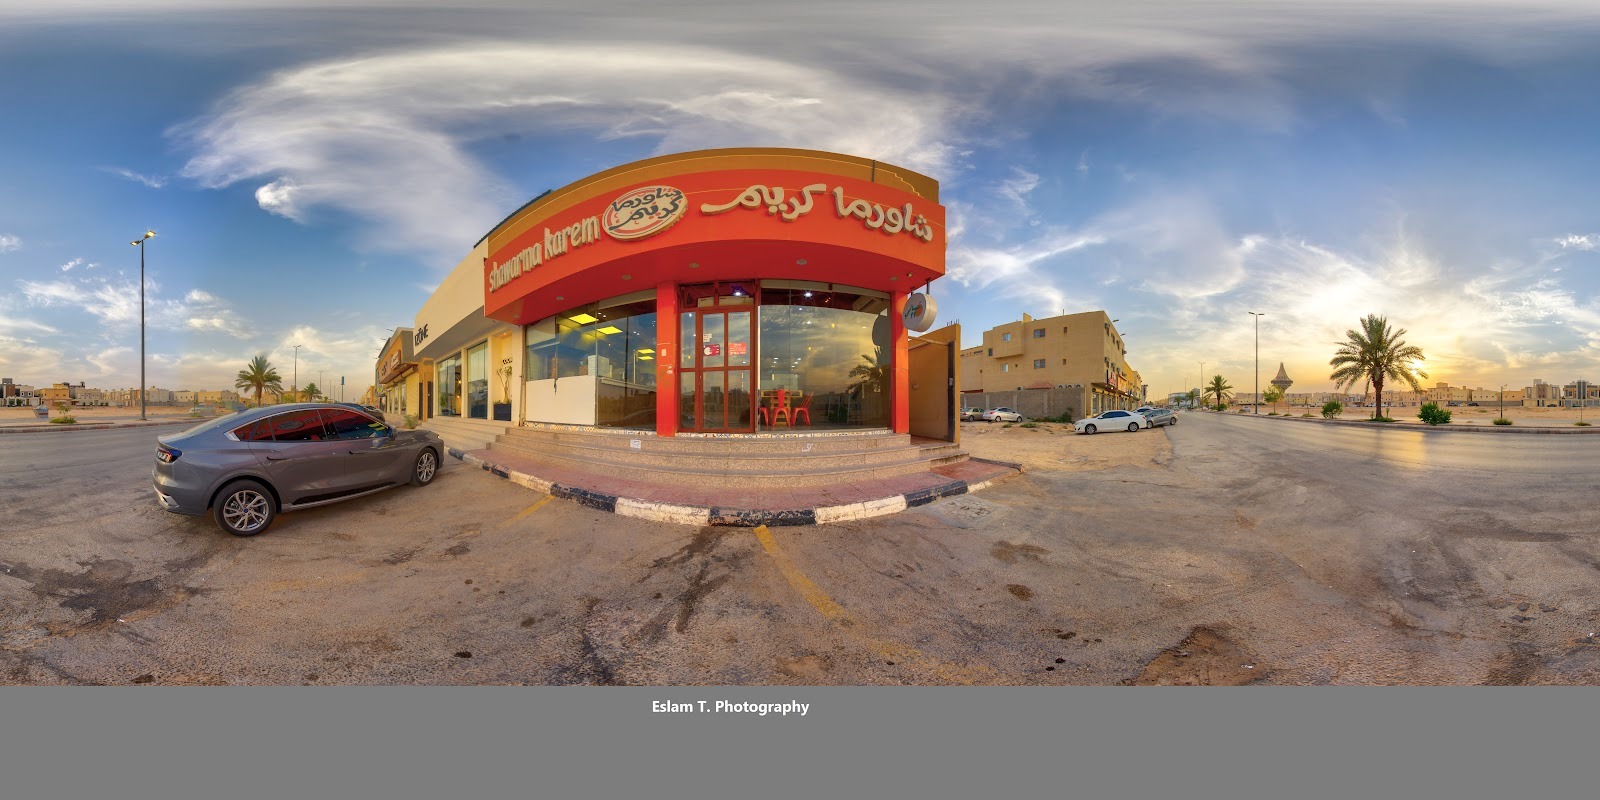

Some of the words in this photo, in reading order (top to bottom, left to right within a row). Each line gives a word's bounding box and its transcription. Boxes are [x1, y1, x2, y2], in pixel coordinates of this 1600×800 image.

[608, 194, 683, 231] كريم
[612, 187, 682, 212] شاورما
[700, 184, 827, 222] كريم
[831, 186, 934, 242] شاورما
[489, 242, 543, 293] shawarma
[544, 216, 601, 261] karem
